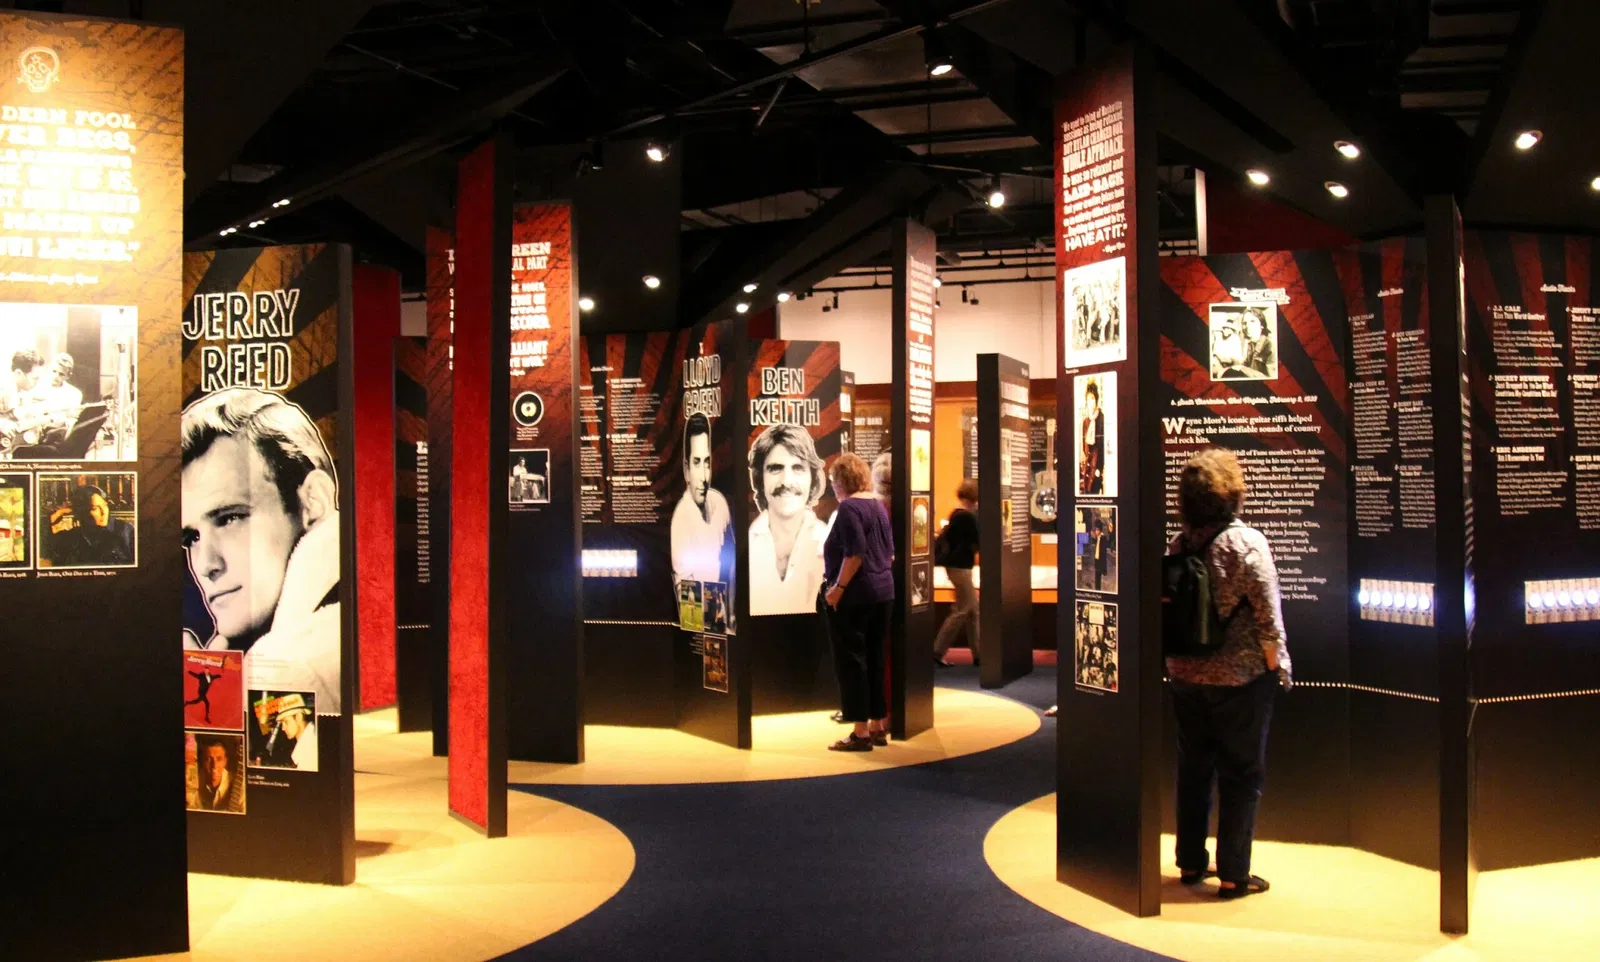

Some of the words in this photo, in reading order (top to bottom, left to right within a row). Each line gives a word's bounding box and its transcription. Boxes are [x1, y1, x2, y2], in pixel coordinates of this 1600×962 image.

[74, 109, 136, 129] FOOL
[1063, 171, 1125, 204] LAID-BACK
[1065, 231, 1096, 252] HAVE
[1095, 227, 1112, 243] AT
[527, 256, 549, 270] PART
[181, 288, 300, 340] JERRY
[201, 342, 292, 392] REED
[682, 354, 722, 388] LLOYD
[762, 367, 804, 396] BEN
[682, 387, 722, 419] GREEN
[750, 398, 820, 426] KEITH
[1186, 426, 1205, 436] forge
[1206, 425, 1217, 434] the
[1218, 425, 1258, 434] identifiable
[1259, 424, 1283, 433] sounds
[1284, 424, 1294, 433] of
[1294, 425, 1322, 434] country
[1228, 416, 1249, 424] iconic
[1250, 415, 1271, 425] guitar
[1288, 414, 1313, 424] helped
[1165, 436, 1178, 444] and
[1179, 436, 1194, 444] rock
[1195, 436, 1210, 444] hits.
[1165, 450, 1186, 459] Inspired
[1187, 450, 1194, 458] by
[1236, 458, 1265, 466] erforming
[188, 656, 206, 666] Jerry
[204, 658, 223, 668] Reed
